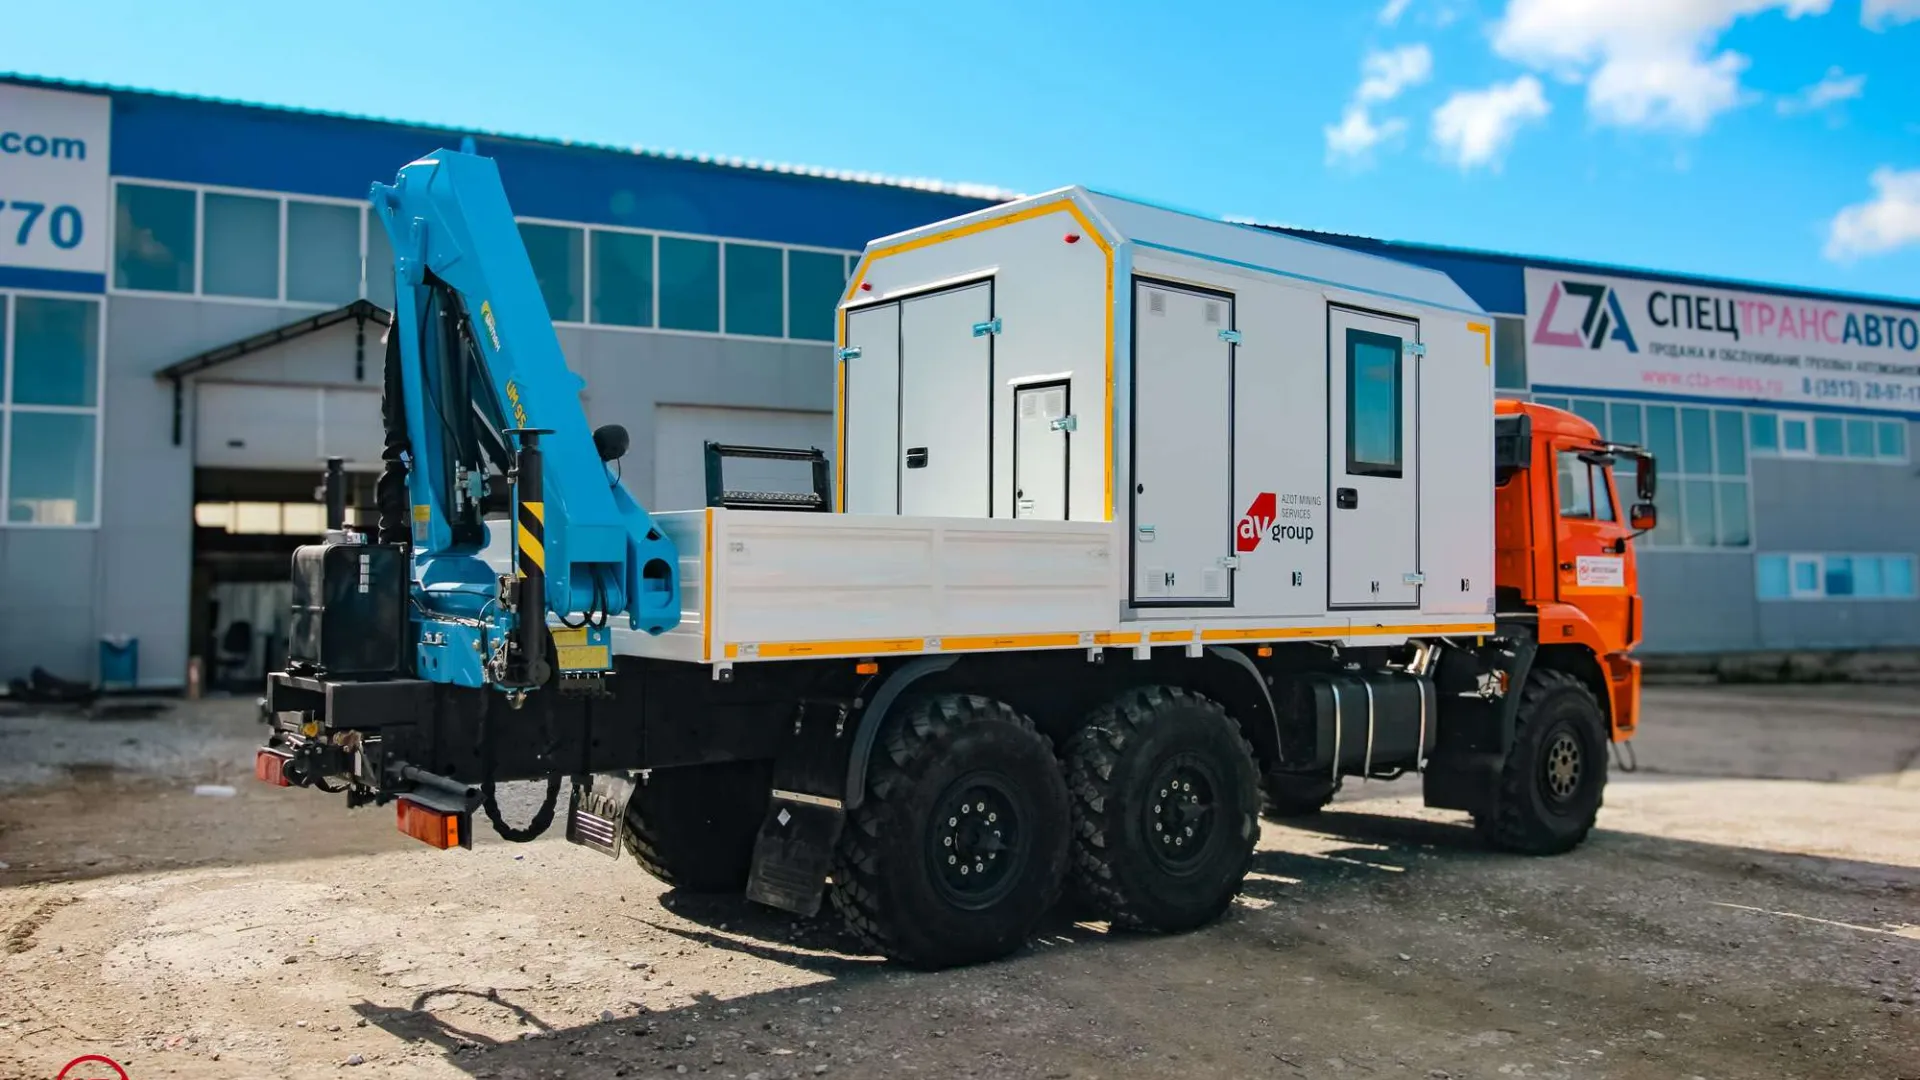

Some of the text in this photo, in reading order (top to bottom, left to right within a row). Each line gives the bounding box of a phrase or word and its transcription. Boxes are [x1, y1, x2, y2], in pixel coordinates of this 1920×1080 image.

[0, 199, 83, 249] 70
[1647, 290, 1919, 352] СПЕЦТРАНСАВТО
[1648, 341, 1705, 359] ПРОДАЖА
[1281, 494, 1322, 506] AZOT MINING
[1281, 508, 1311, 519] SERVICES
